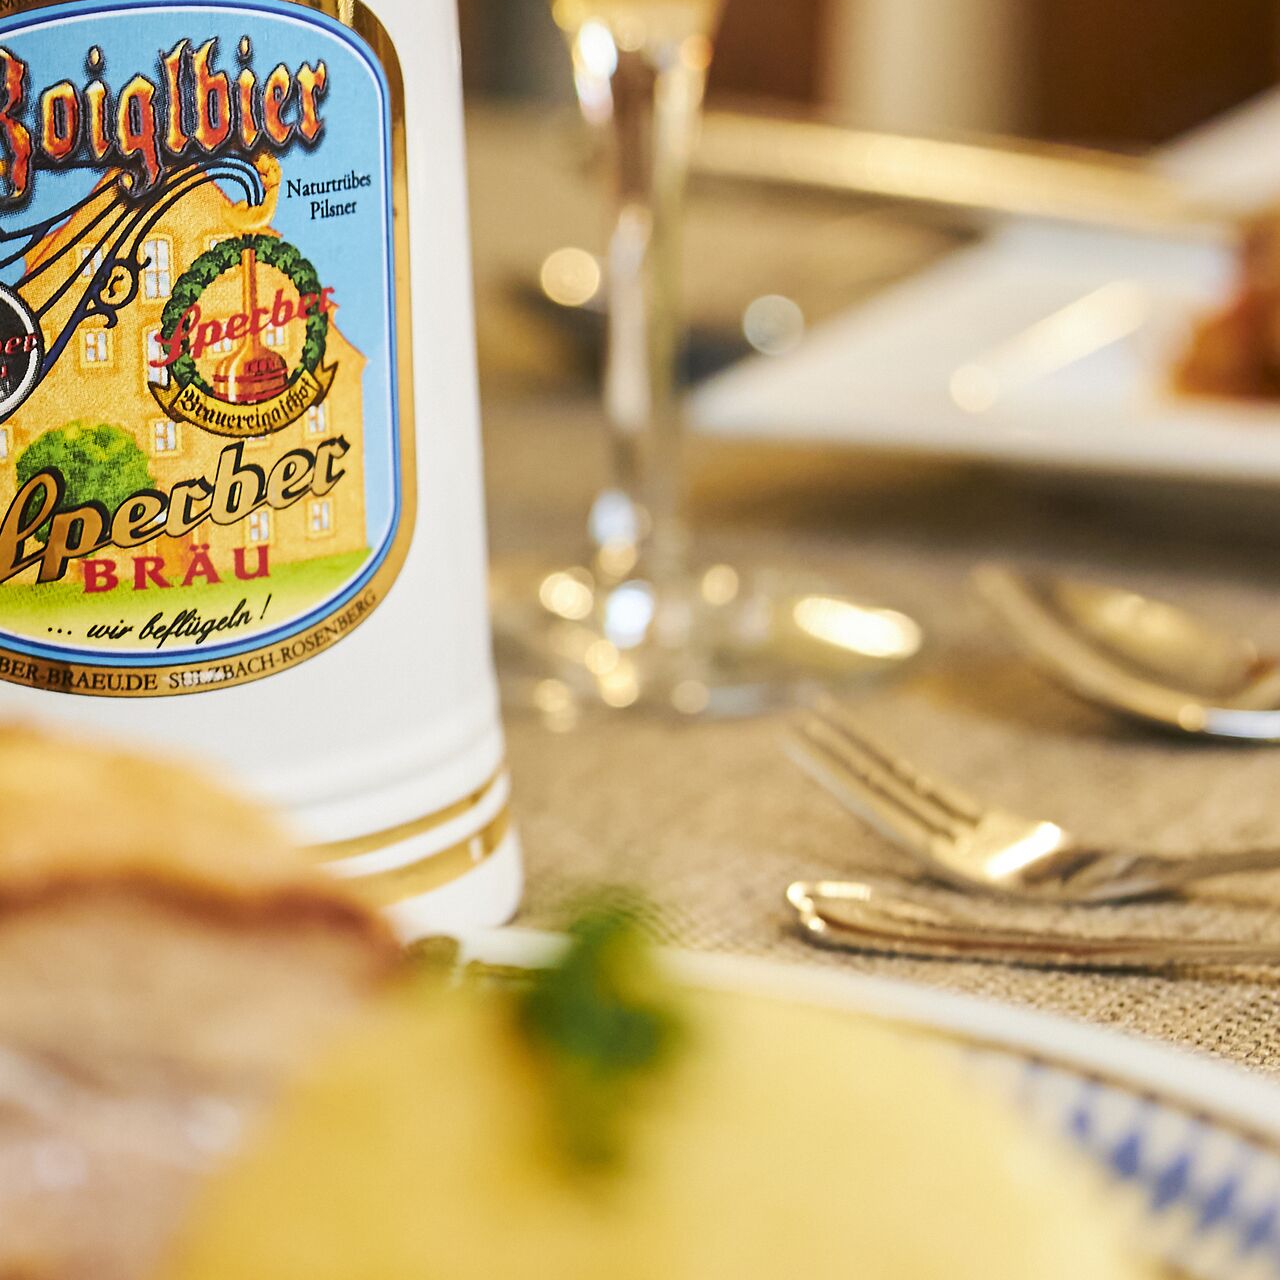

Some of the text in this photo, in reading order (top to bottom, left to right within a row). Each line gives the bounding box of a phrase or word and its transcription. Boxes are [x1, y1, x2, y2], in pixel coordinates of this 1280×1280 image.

[286, 169, 372, 199] Naturtrübes
[310, 199, 357, 220] Pilsner
[149, 285, 336, 368] Sperber
[81, 542, 272, 595] BRÄU
[86, 621, 134, 640] wir
[138, 597, 254, 650] beflügeln
[169, 588, 378, 689] SULZBACH-ROSENBERG
